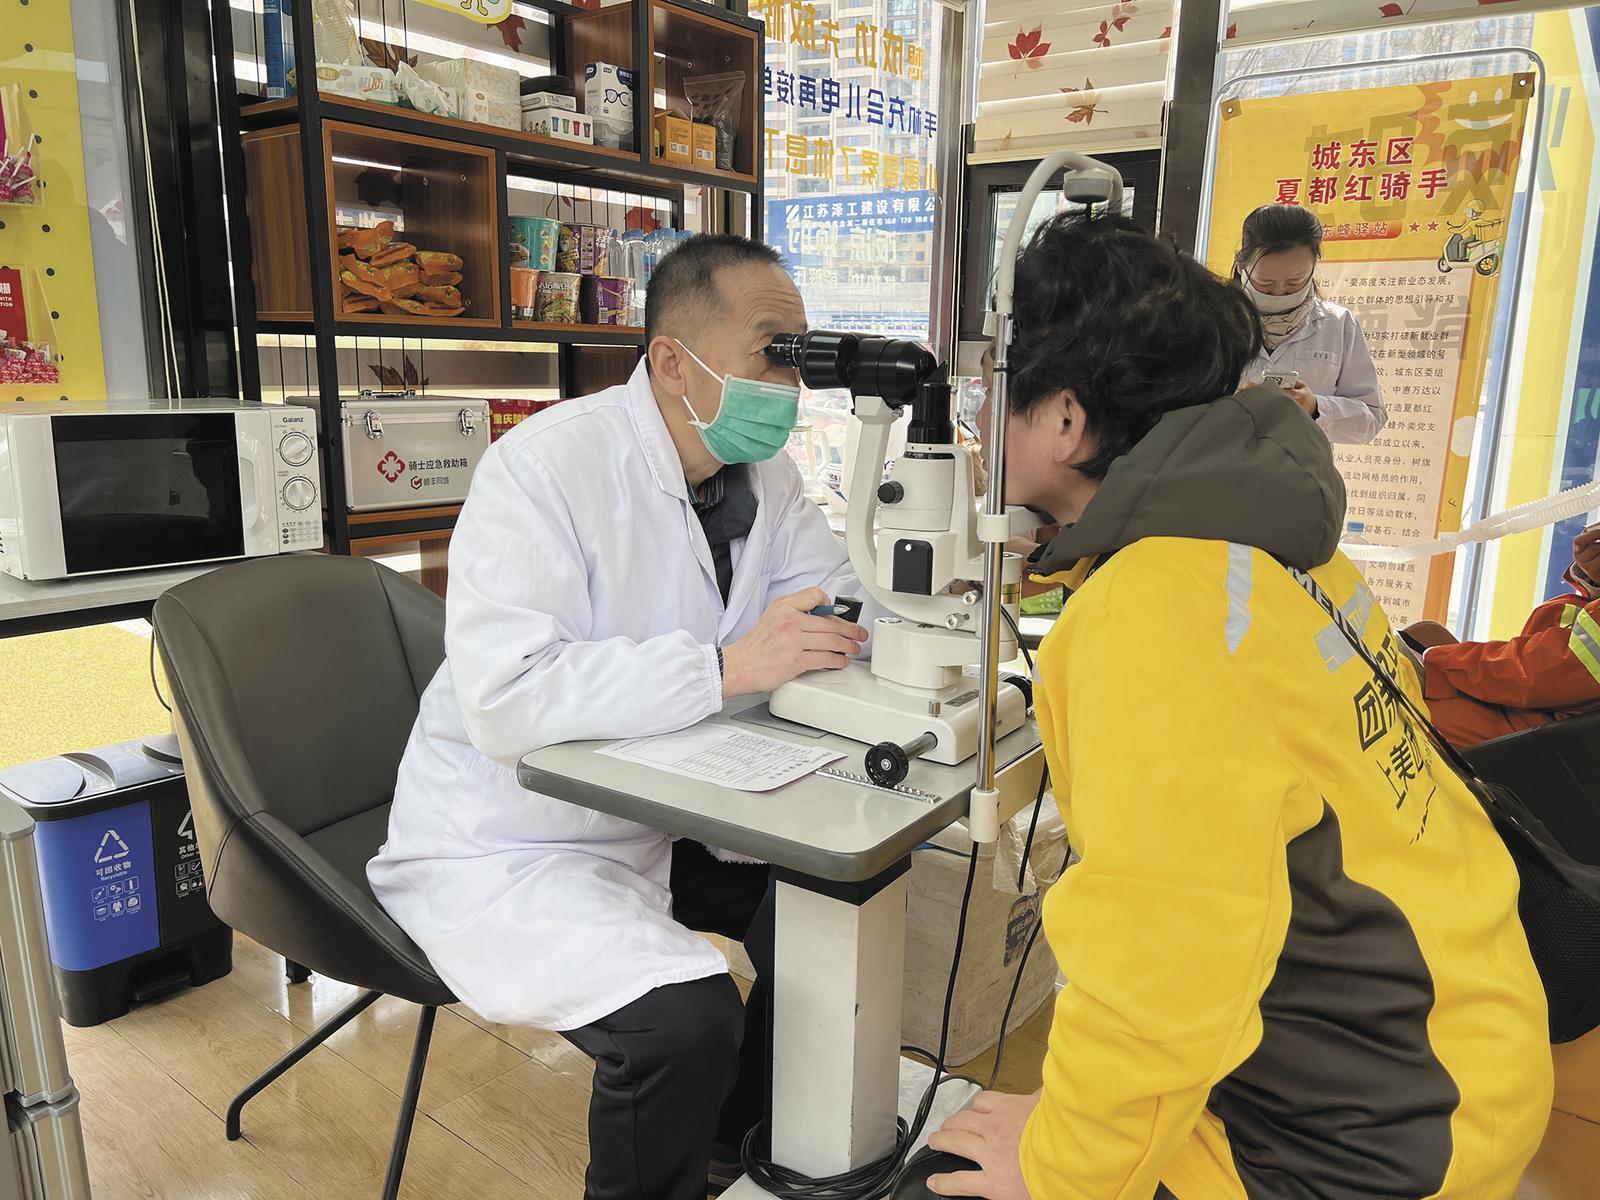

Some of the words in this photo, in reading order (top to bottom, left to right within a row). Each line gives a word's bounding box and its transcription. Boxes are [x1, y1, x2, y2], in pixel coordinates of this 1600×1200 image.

[1312, 137, 1414, 170] 城东区
[1275, 168, 1449, 206] 夏都红骑手
[282, 416, 304, 424] Galanz
[1383, 421, 1436, 432] 蜂外卖党支
[409, 458, 468, 471] 骑士应急救助箱
[1333, 453, 1432, 468] 从业人员亮身份、树旗
[1346, 488, 1426, 503] 找到组织归属。同
[95, 861, 132, 877] 可回收物
